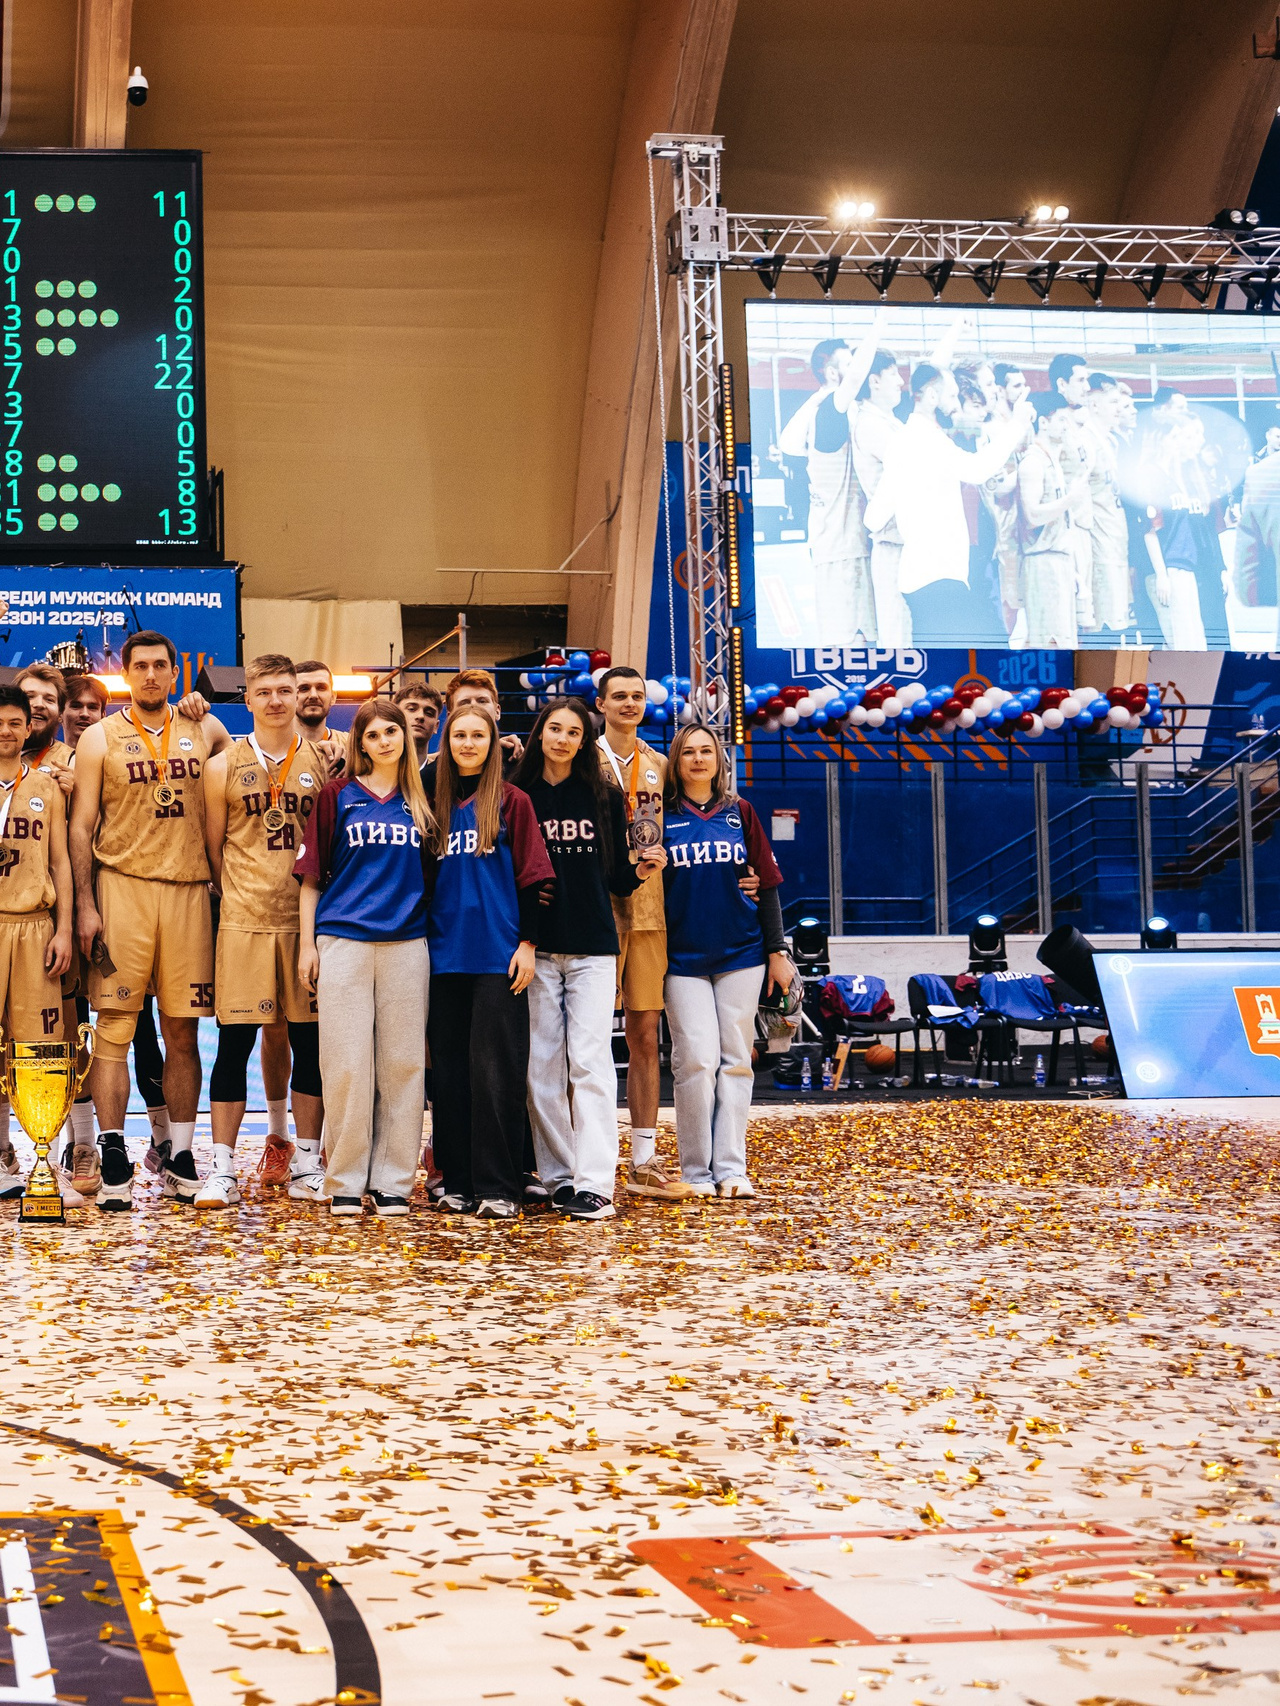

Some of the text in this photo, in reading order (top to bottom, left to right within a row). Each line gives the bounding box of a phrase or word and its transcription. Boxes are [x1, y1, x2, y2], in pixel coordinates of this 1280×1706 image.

[3, 189, 16, 217] 1
[153, 190, 186, 218] 11
[2, 218, 22, 245] 7
[173, 219, 192, 246] 0
[173, 247, 192, 275] 0
[173, 277, 193, 304] 2
[174, 305, 193, 332] 0
[155, 335, 194, 363] 12
[153, 363, 194, 390] 22
[176, 393, 195, 421] 0
[176, 421, 195, 448] 0
[177, 451, 196, 479] 5
[177, 479, 196, 507] 8
[158, 509, 197, 536] 13
[49, 590, 142, 606] МУЖСКИХ
[145, 592, 222, 608] КОМАНД
[47, 611, 125, 627] 2025/26
[845, 674, 867, 684] 2016
[998, 651, 1057, 685] 2026
[541, 818, 596, 842] ИВС
[670, 841, 747, 869] ЦИВС
[189, 982, 214, 1008] 35
[40, 1007, 60, 1035] 17
